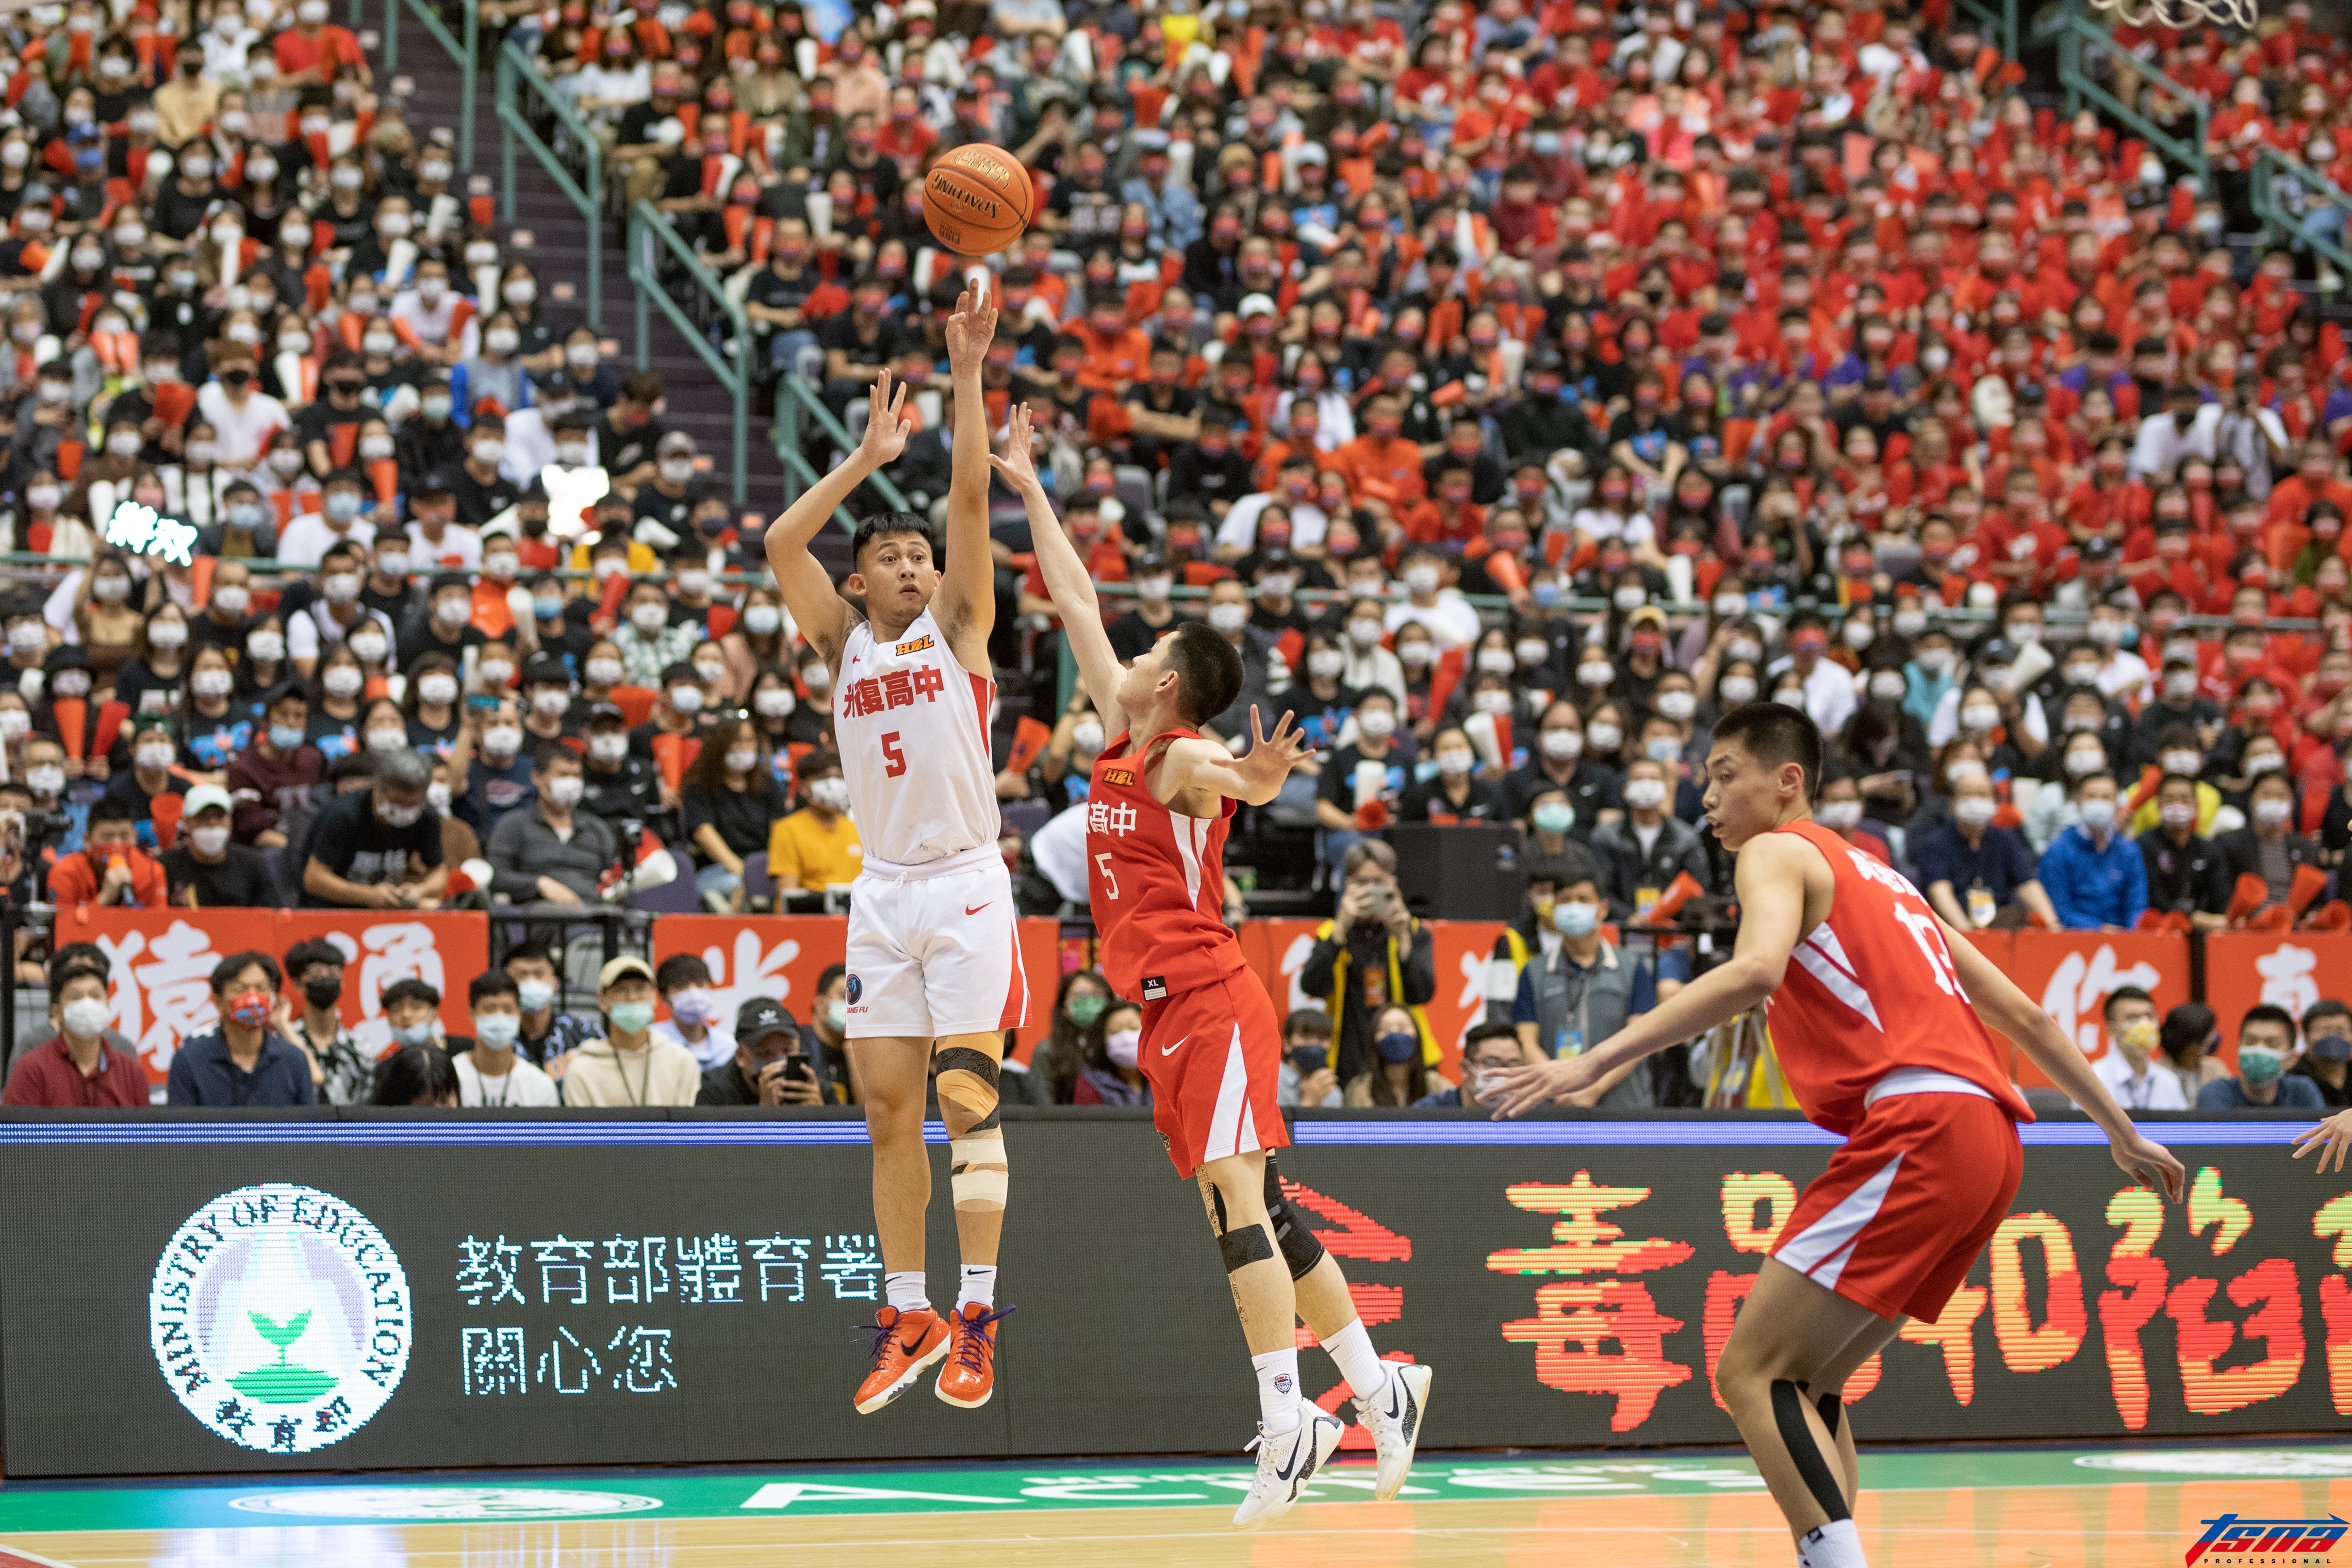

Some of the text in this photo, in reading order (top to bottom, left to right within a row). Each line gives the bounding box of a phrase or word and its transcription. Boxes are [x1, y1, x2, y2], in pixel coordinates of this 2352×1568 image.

[931, 172, 1002, 219] SPALDING
[896, 634, 935, 656] HBL
[881, 731, 907, 778] 5
[1103, 768, 1134, 786] HBL
[1087, 800, 1137, 838] 高中
[1094, 852, 1120, 900] 5
[1147, 979, 1159, 987] XL
[456, 1231, 883, 1306] 教育部體育署
[158, 1194, 404, 1395] MINISTRY OF EDUCATION
[461, 1325, 678, 1396] 關心您
